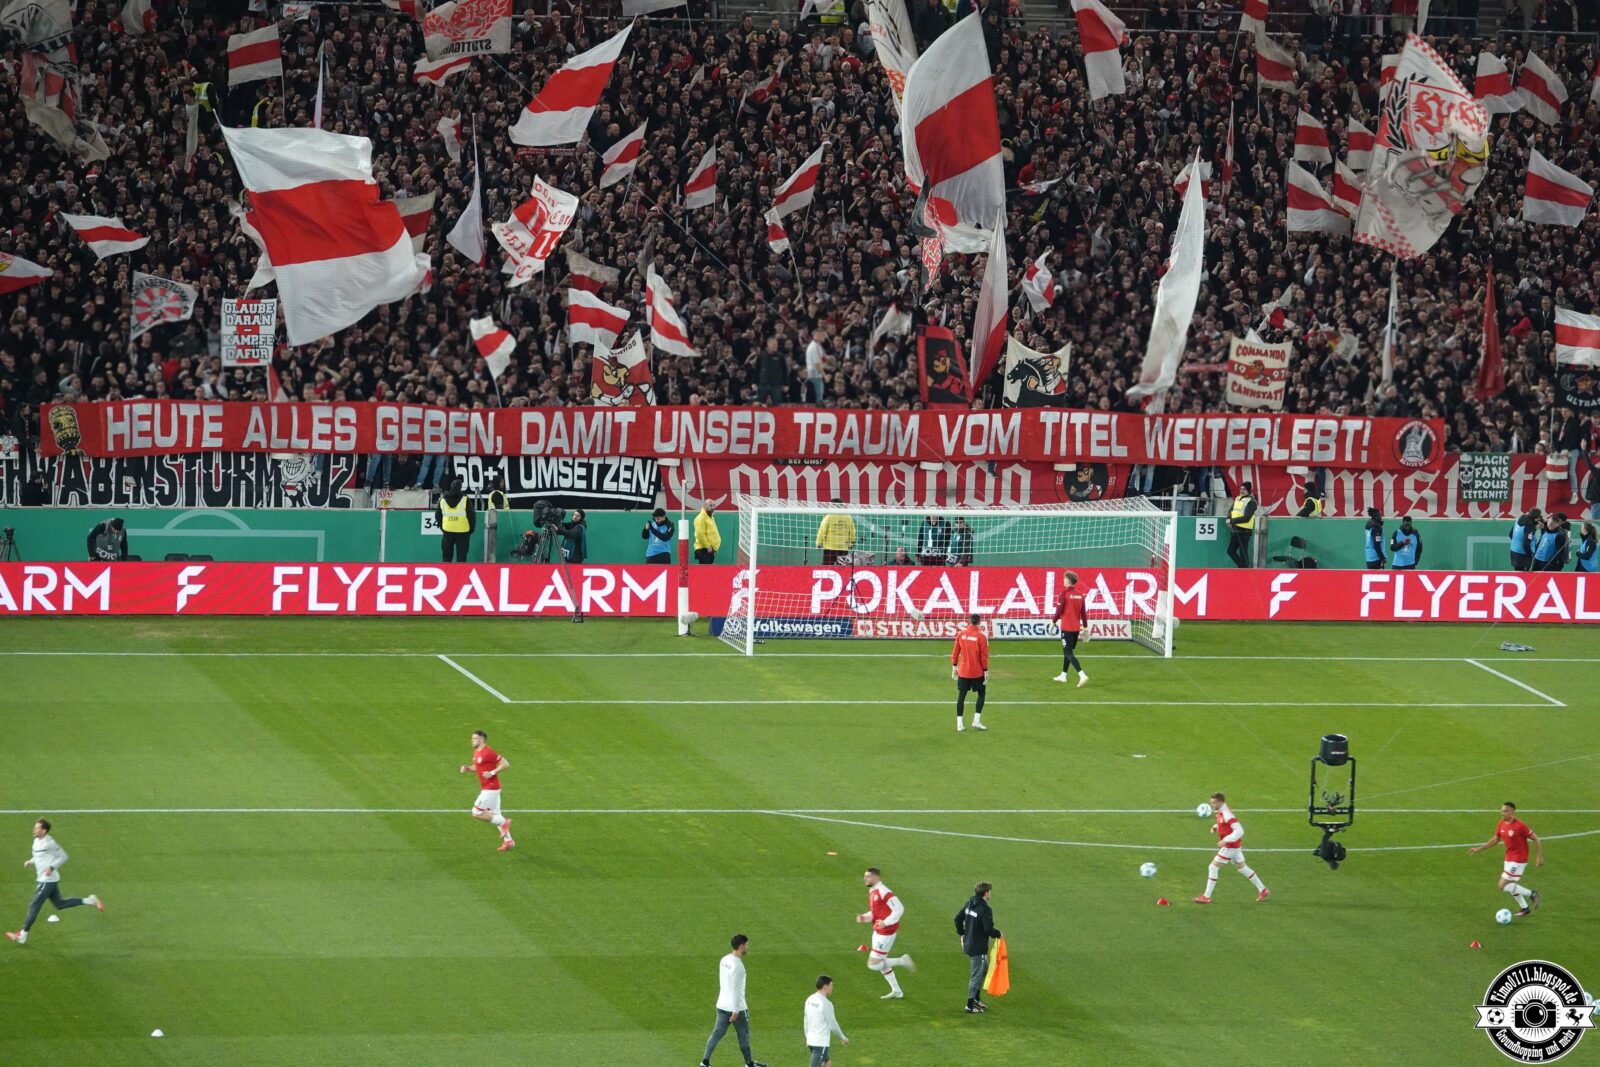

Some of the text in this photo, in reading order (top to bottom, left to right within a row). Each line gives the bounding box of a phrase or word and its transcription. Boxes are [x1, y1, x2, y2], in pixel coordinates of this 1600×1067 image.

[224, 302, 275, 314] GLAUBE
[225, 314, 272, 326] DARAN
[223, 331, 274, 346] KÄMPFE
[226, 345, 269, 360] DAFÜR
[1236, 344, 1286, 362] COMMANDO
[1233, 364, 1247, 374] 19
[1272, 370, 1286, 379] 97
[1231, 381, 1284, 401] CANNSTATT
[107, 403, 1372, 463] HEUTE ALLES GEBEN, DAMIT UNSER TRAUM VOM TITEL WEITERLEBT!
[1474, 455, 1510, 465] MAGIC
[453, 456, 658, 496] 50+1 UMSETZEN!
[1474, 466, 1509, 479] FANS
[668, 458, 1032, 508] Commando
[1055, 476, 1116, 486] 19 97
[1474, 479, 1508, 489] POUR
[1199, 523, 1215, 535] 35
[96, 547, 117, 560] FOTO
[273, 566, 668, 613] FLYERALARM
[811, 570, 1208, 616] POKALALARM
[752, 620, 841, 635] Volkswagen
[996, 623, 1060, 636] TARGO
